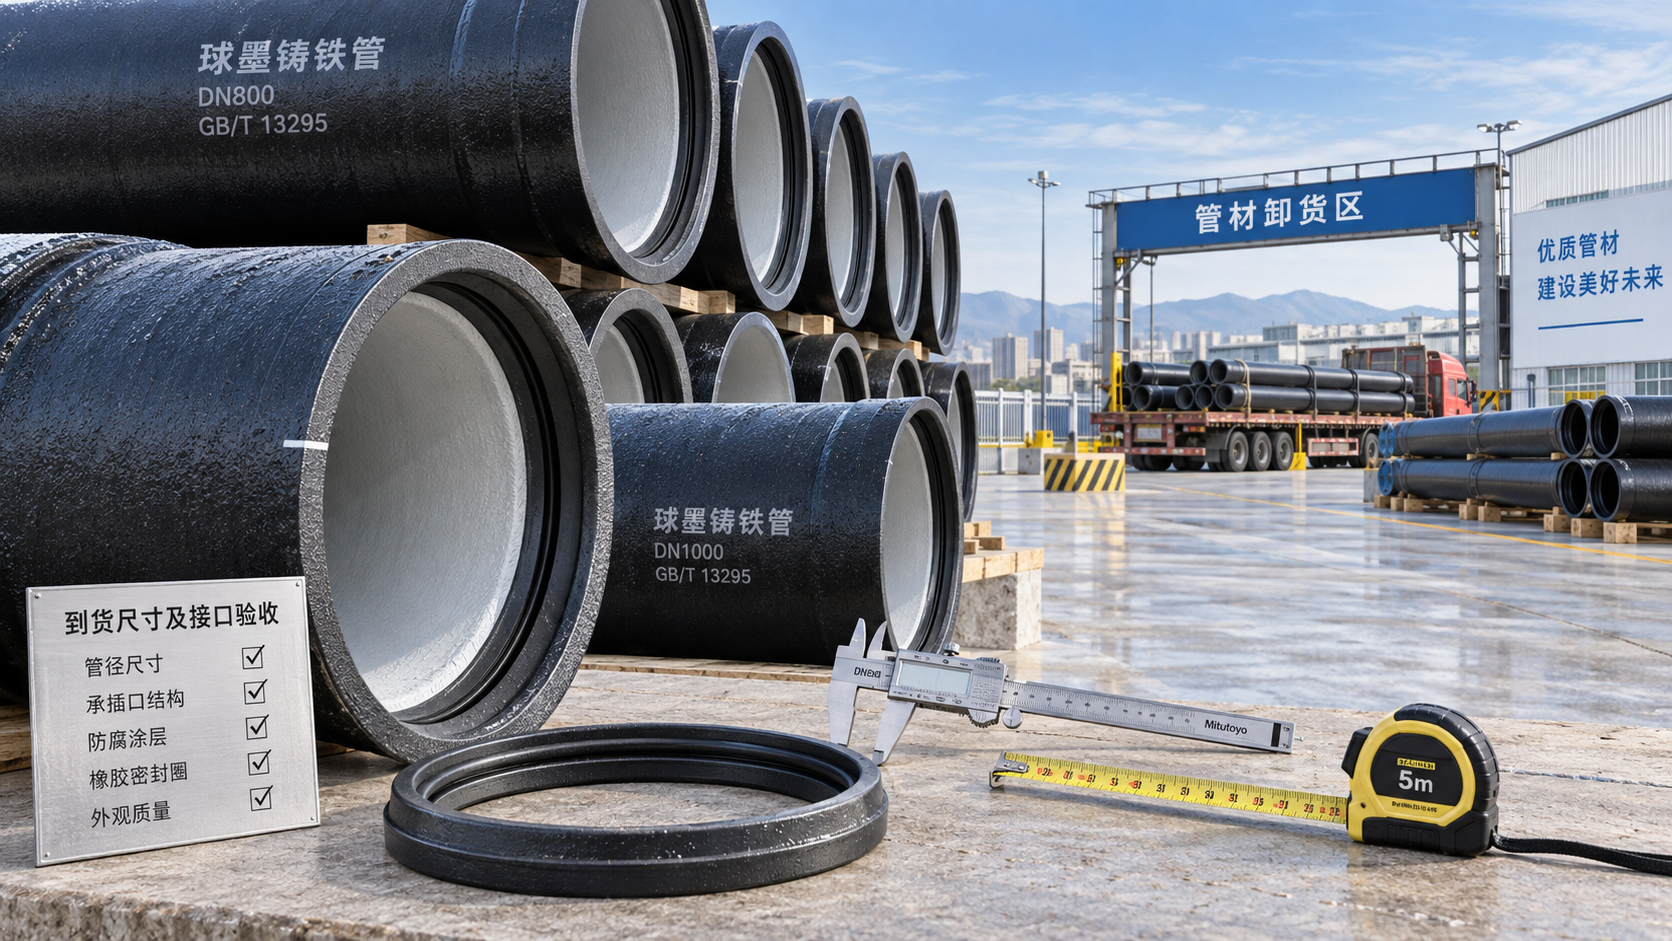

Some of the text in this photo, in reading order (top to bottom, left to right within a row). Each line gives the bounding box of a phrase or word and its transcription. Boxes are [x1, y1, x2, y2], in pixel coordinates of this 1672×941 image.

[198, 36, 385, 75] 球墨铸铁管
[198, 84, 275, 107] DN800
[198, 113, 328, 137] GB/T 13295
[1195, 191, 1364, 234] 管材卸货区
[1537, 229, 1619, 263] 优质管材
[1537, 264, 1663, 301] 建设美好未来
[653, 506, 793, 536] 球墨铸铁管
[654, 542, 724, 560] DN1000
[655, 567, 752, 584] GB/T 13295
[65, 601, 279, 636] 到货尺寸及接口验收
[85, 653, 163, 678] 管径尺寸
[86, 688, 185, 715] 承插口结构
[88, 726, 167, 753] 防腐涂层
[1204, 719, 1248, 735] Mitutoyo
[89, 761, 188, 790] 橡胶密封圈
[1398, 769, 1433, 793] 5m
[91, 800, 171, 828] 外观质量
